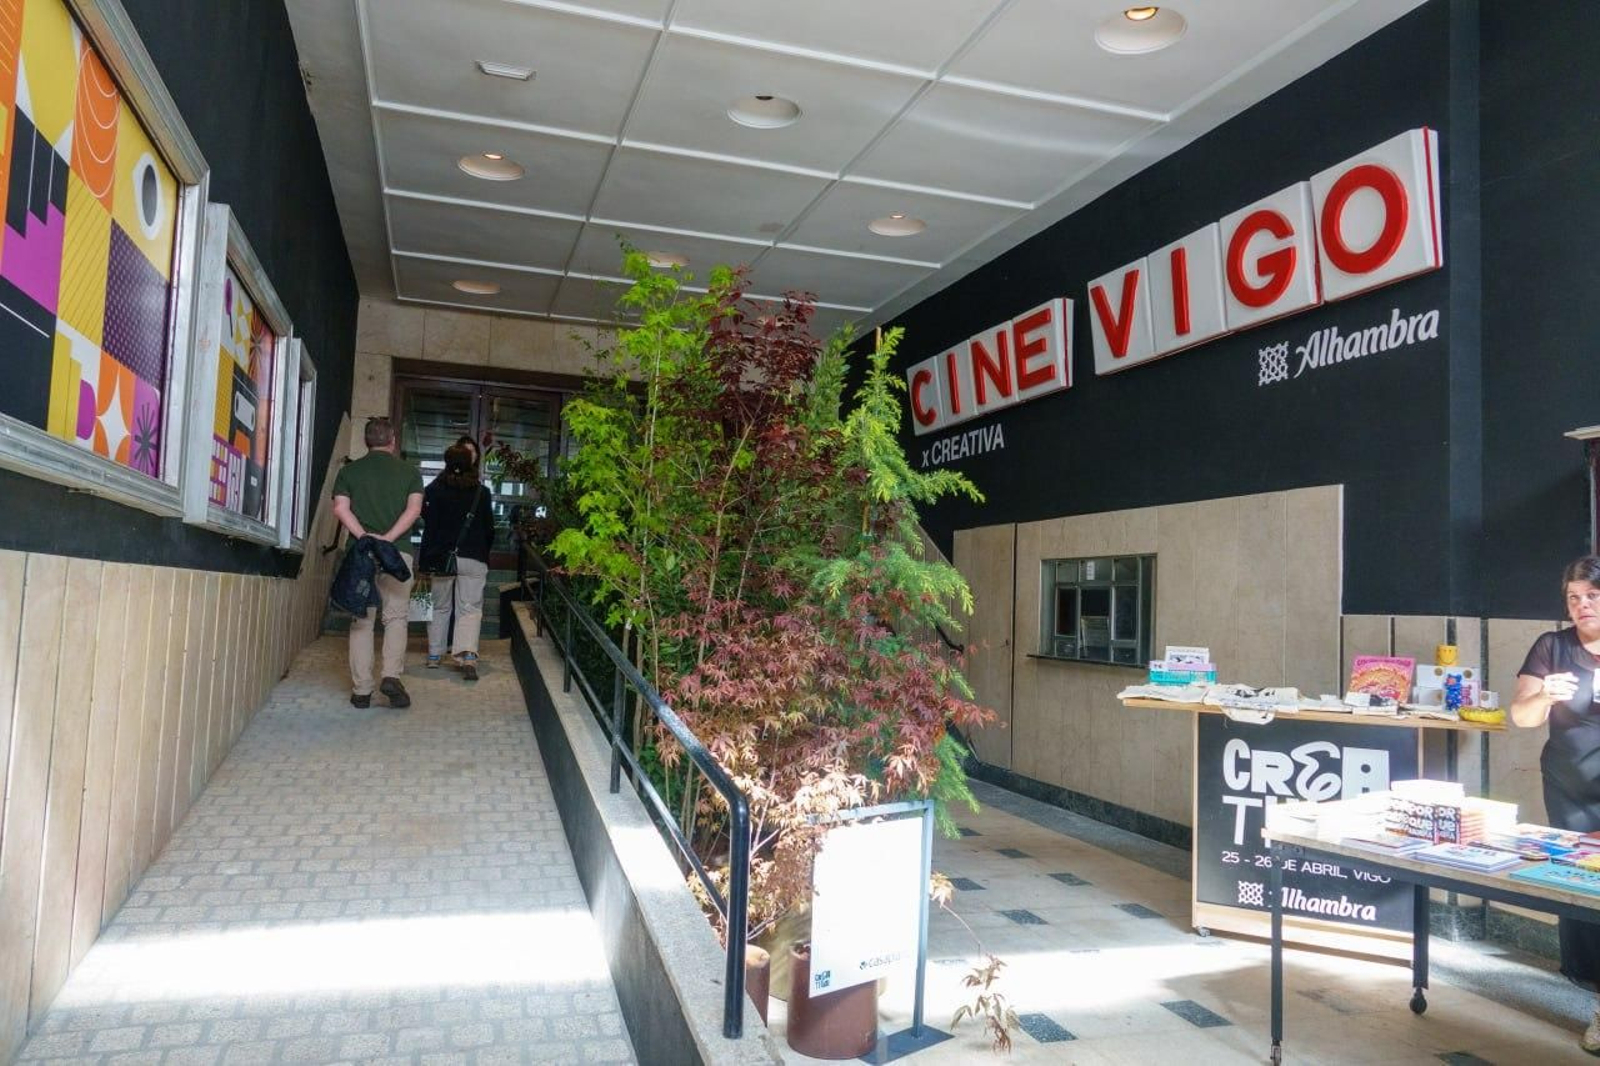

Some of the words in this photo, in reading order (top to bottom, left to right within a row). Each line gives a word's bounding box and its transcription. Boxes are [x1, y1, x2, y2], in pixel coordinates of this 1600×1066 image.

[911, 307, 1055, 426] CINE
[1089, 163, 1409, 359] VIGO
[1294, 307, 1440, 378] Alhambra
[931, 422, 1005, 465] CREATIVA
[1222, 850, 1240, 864] 25
[1254, 855, 1273, 868] 26
